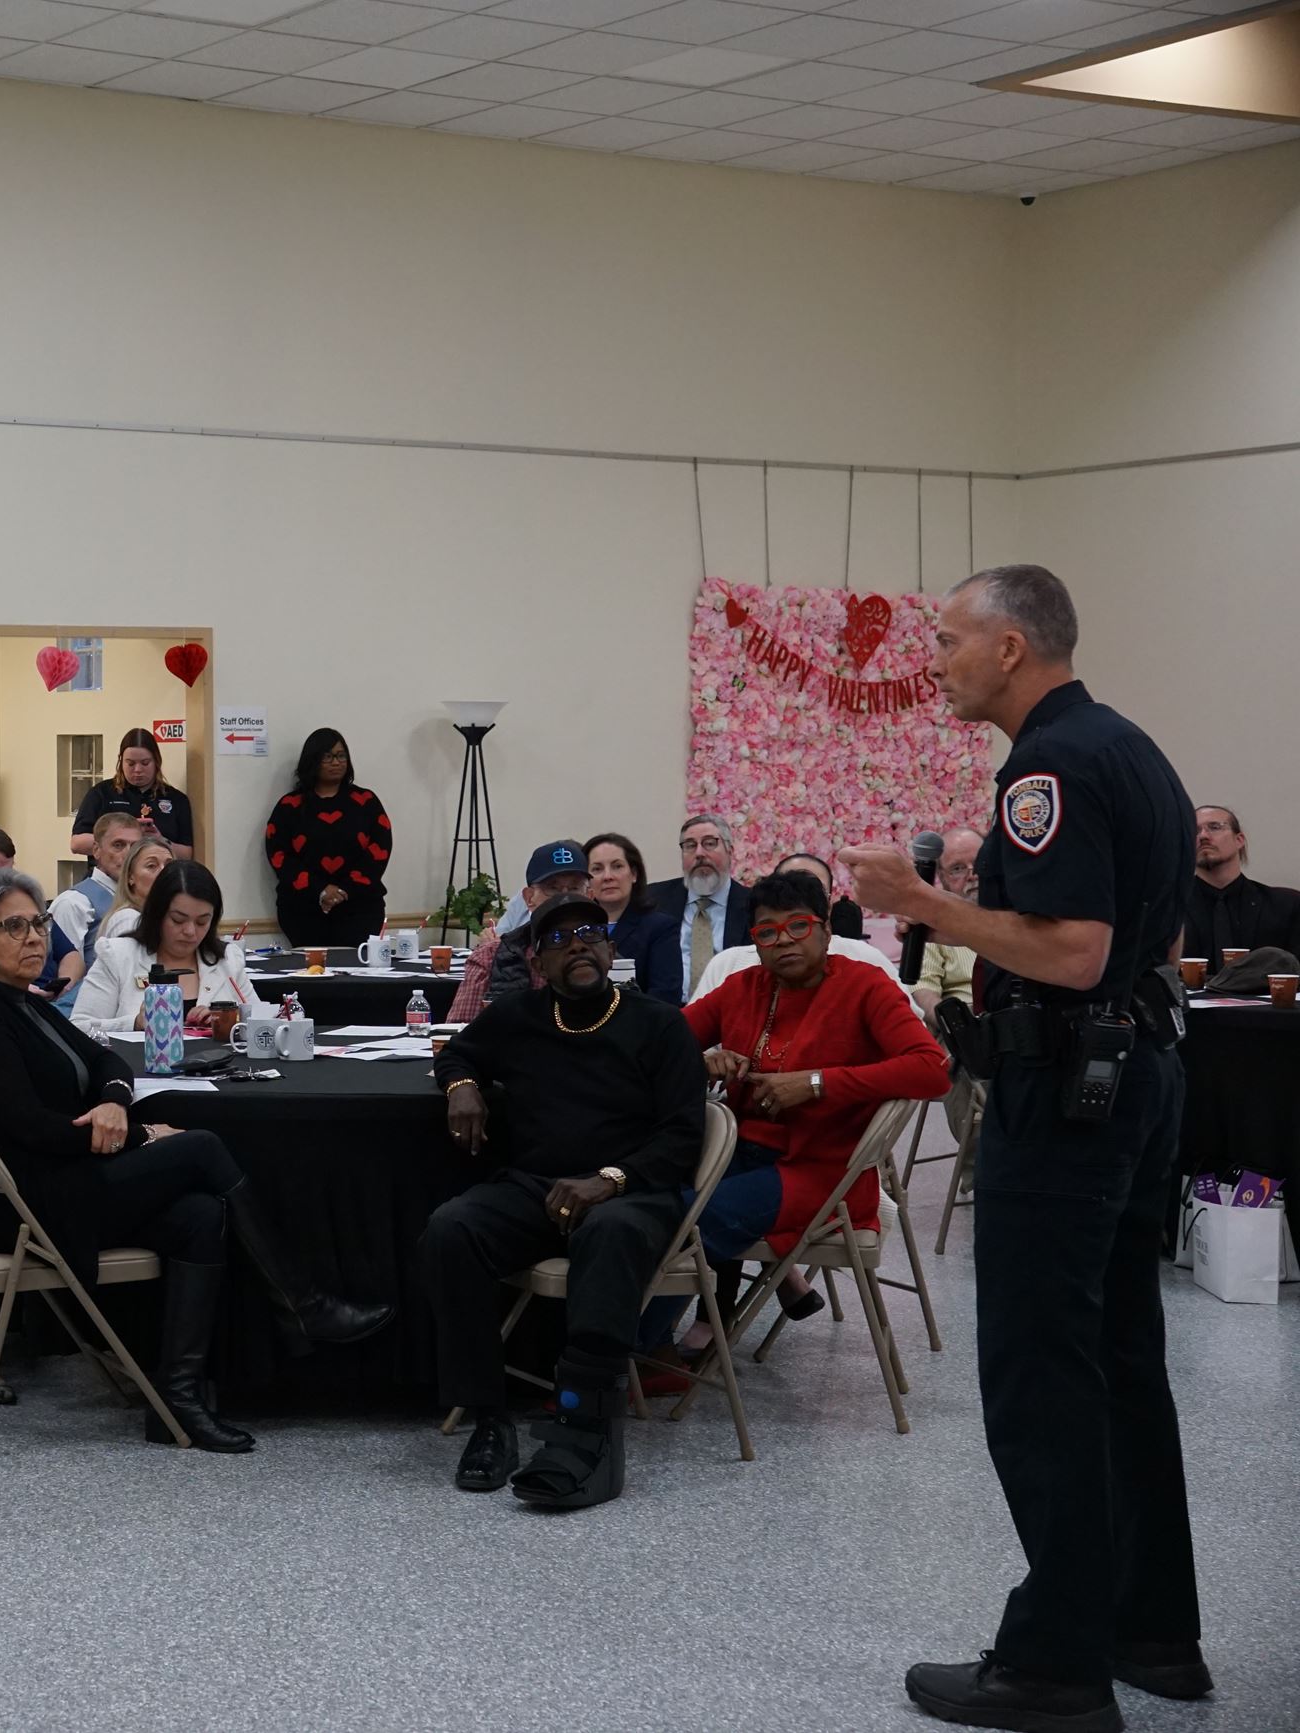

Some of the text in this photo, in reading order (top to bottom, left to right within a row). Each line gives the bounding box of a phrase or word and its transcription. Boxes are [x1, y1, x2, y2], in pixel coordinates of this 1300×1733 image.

[746, 622, 937, 714] HAPPY VALENTINES
[220, 717, 264, 725] Staff Offices
[167, 725, 183, 737] AED
[1009, 780, 1050, 798] TOMBALL
[1019, 825, 1048, 838] POLICE
